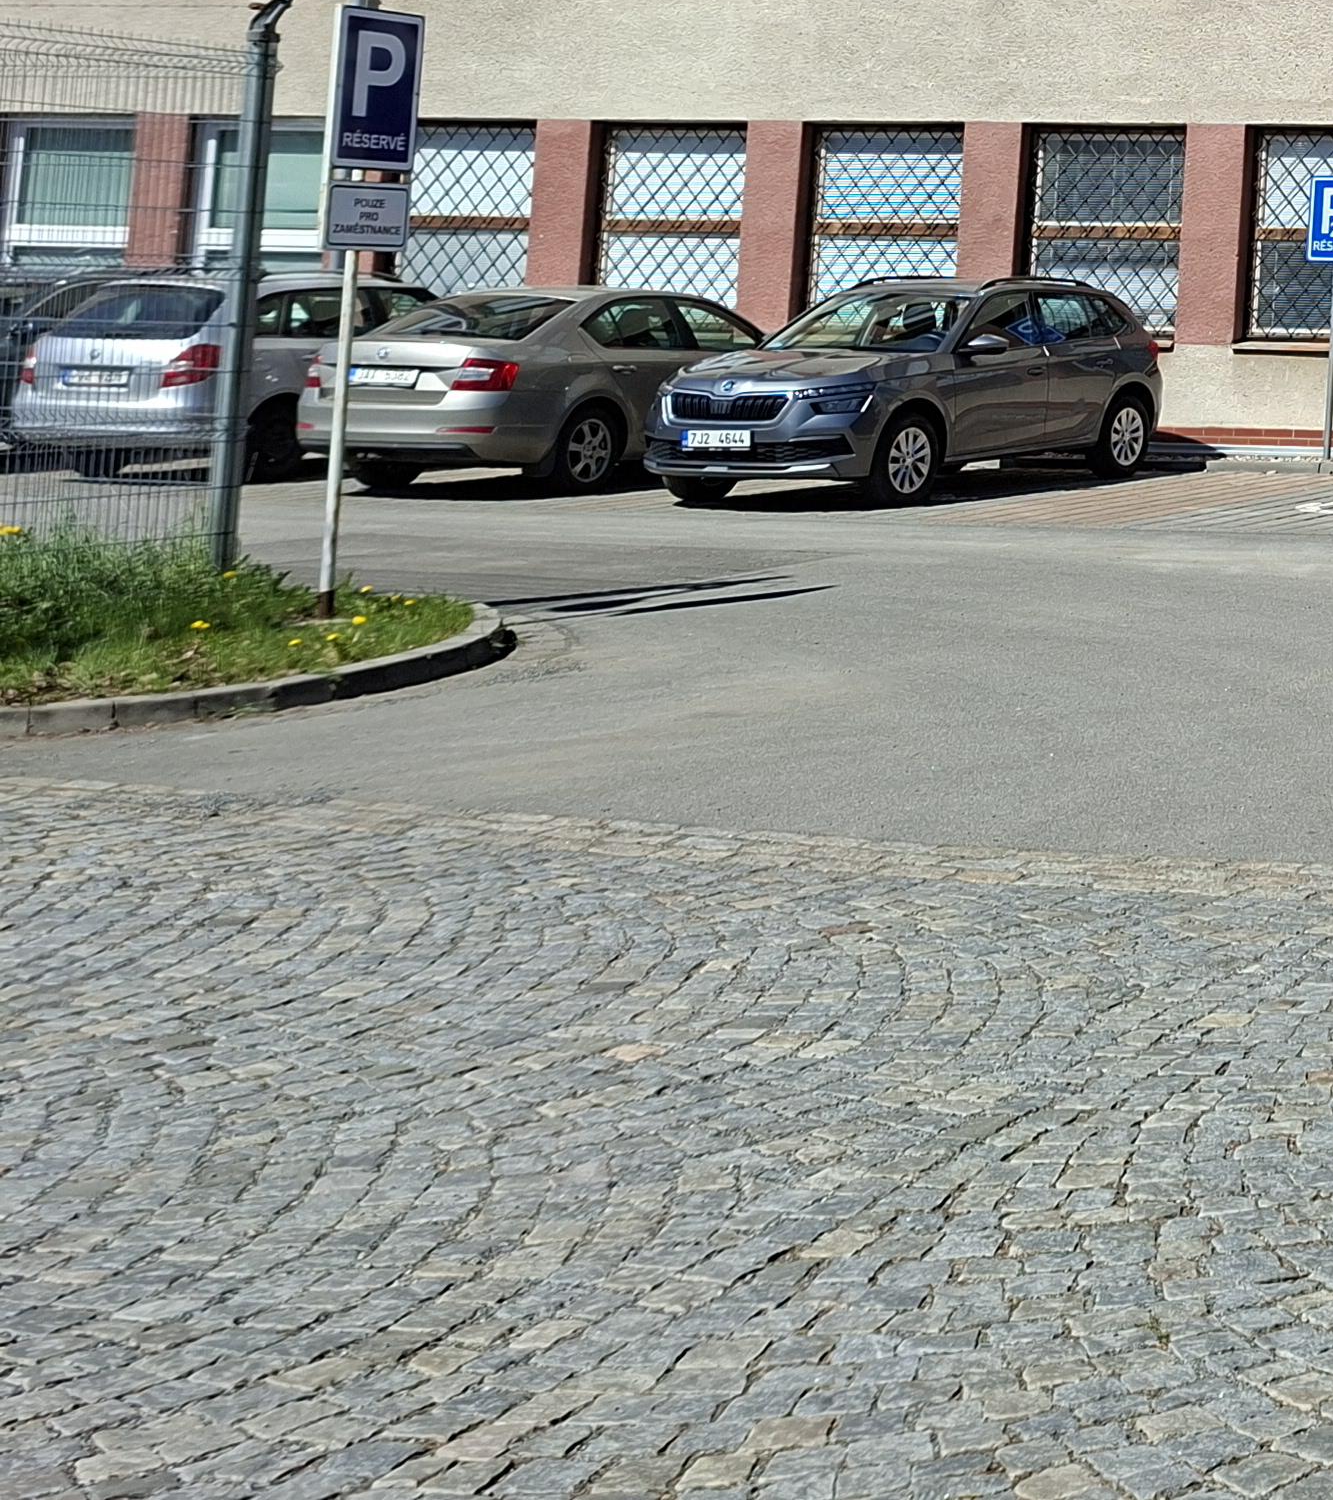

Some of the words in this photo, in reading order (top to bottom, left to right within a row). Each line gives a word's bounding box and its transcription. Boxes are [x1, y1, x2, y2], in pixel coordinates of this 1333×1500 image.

[352, 30, 406, 117] P
[342, 129, 406, 151] RÉSERVÉ
[353, 198, 386, 209] POUZE
[359, 212, 379, 222] PRO
[690, 433, 710, 444] 7J2
[718, 432, 744, 444] 4644
